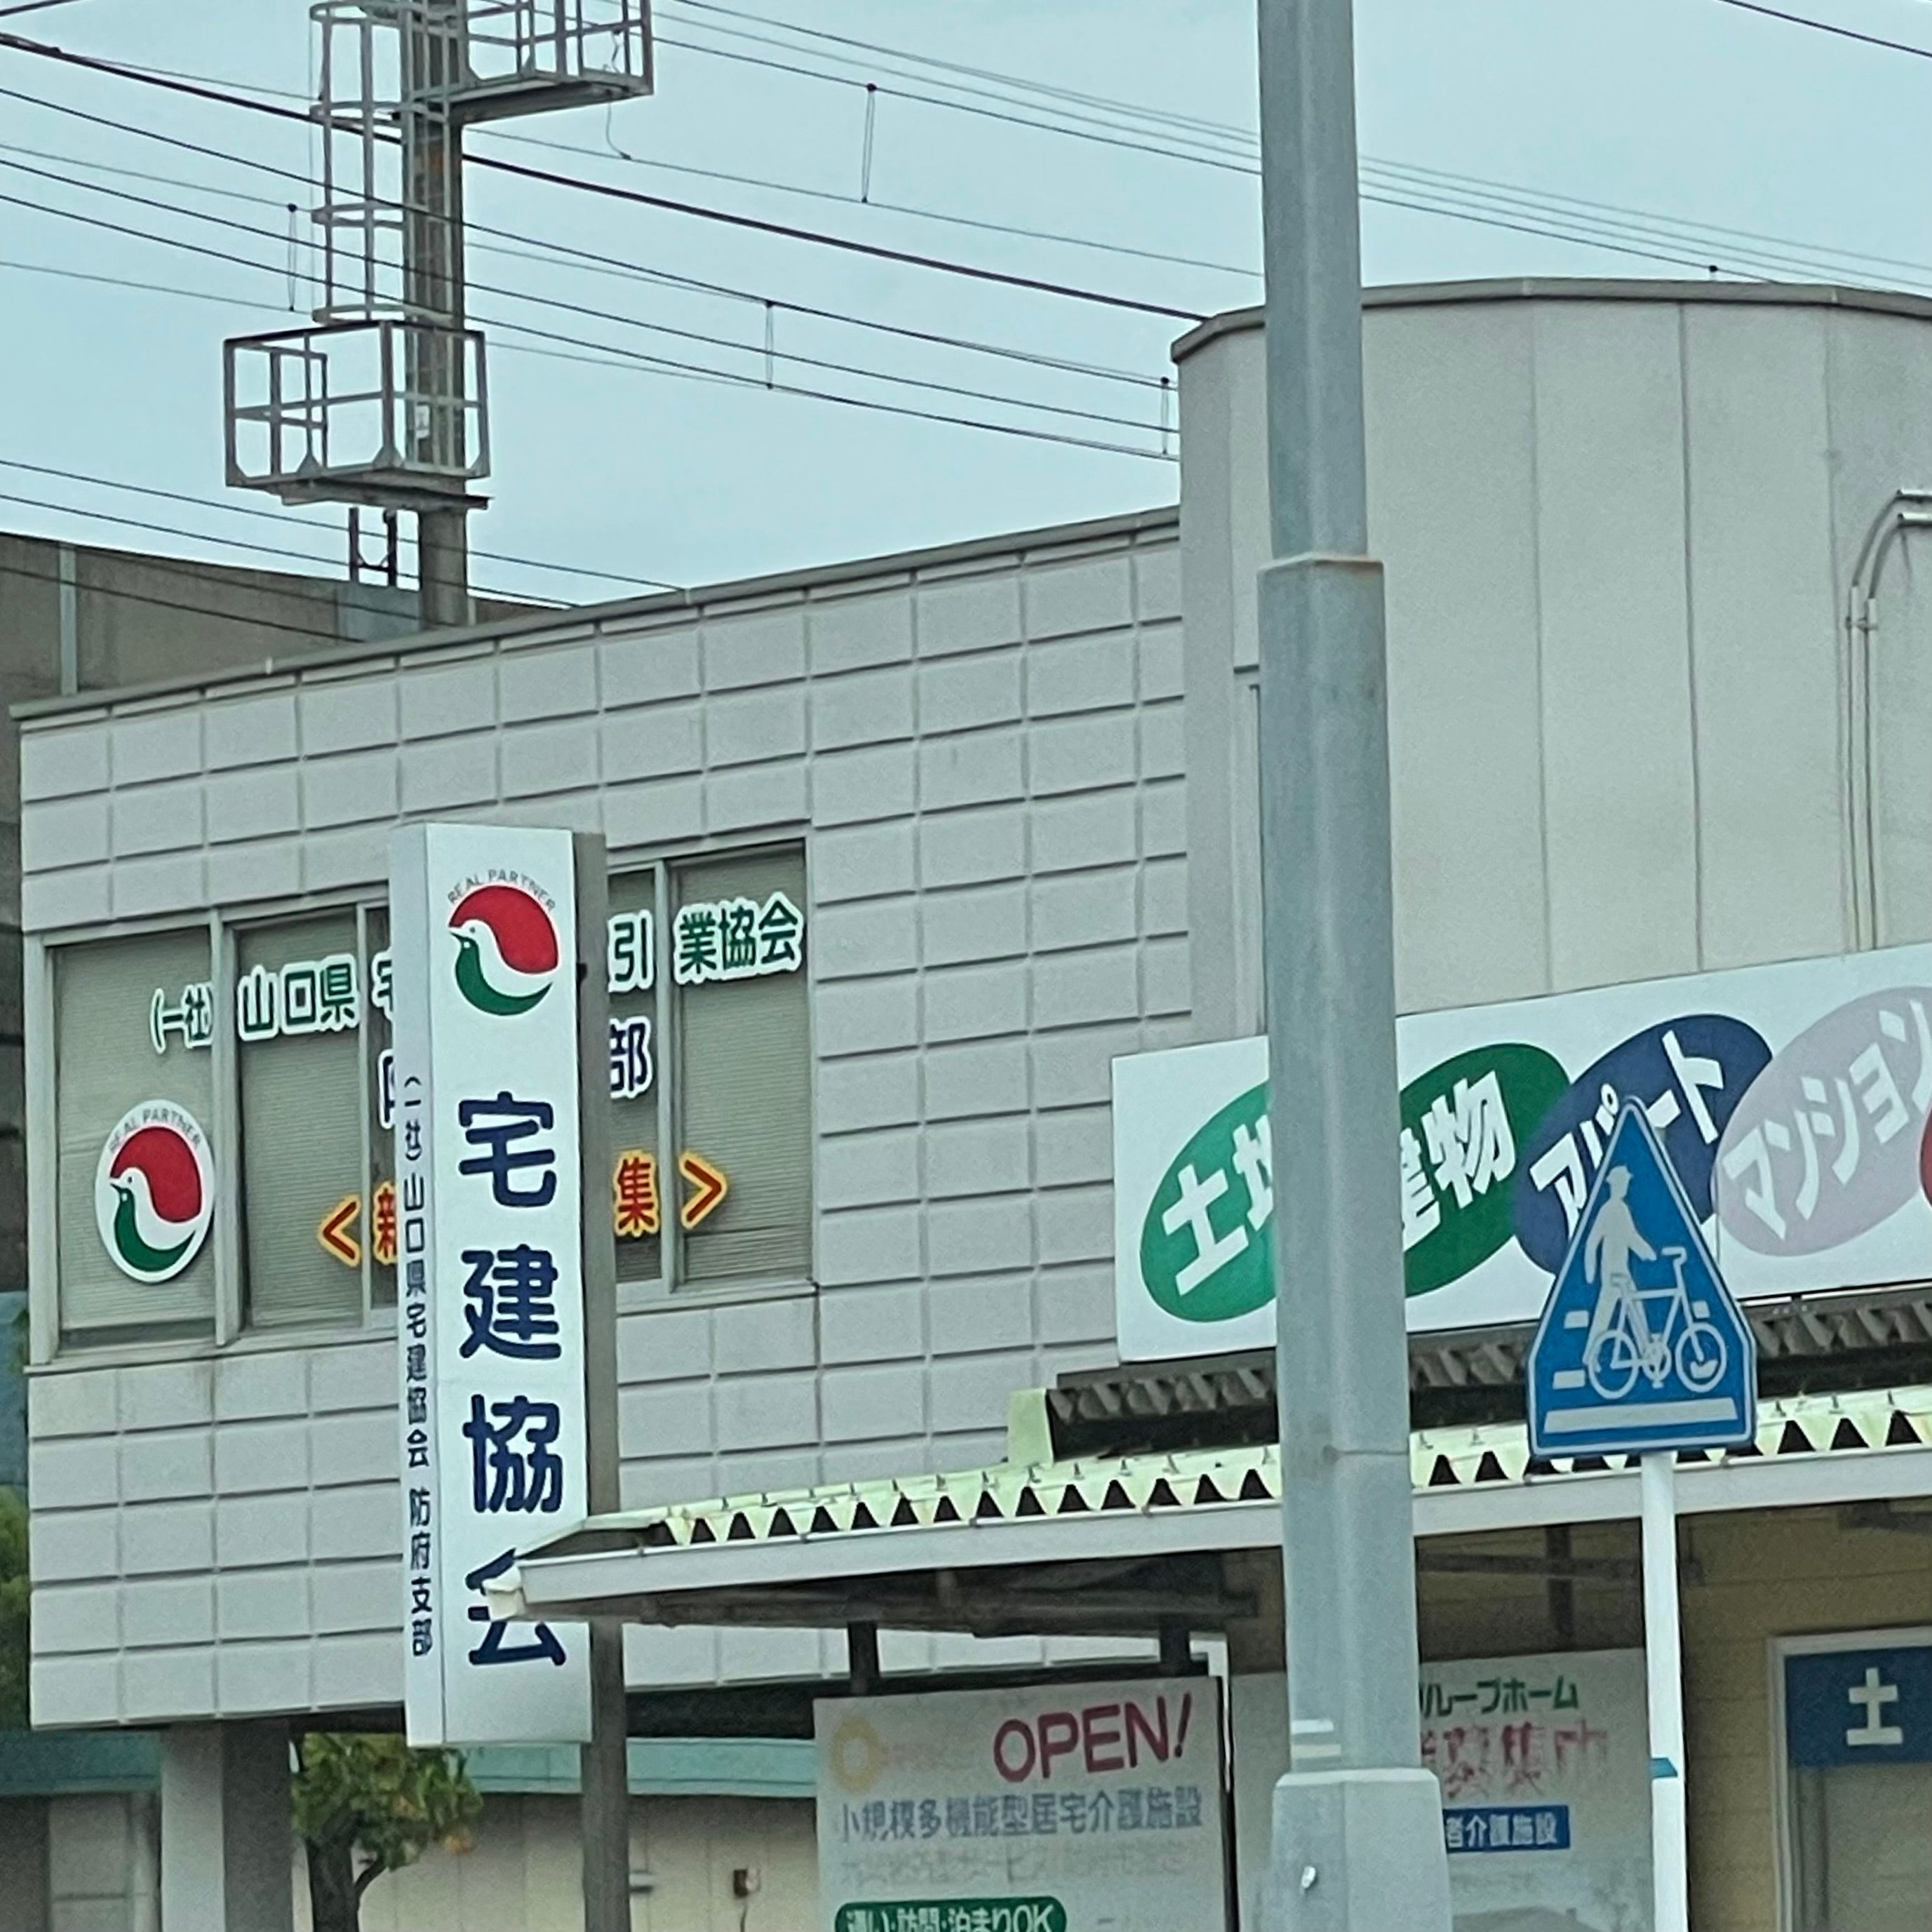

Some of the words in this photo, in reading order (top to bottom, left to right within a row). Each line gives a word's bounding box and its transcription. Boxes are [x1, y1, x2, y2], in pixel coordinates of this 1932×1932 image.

[448, 874, 482, 904] REAL
[488, 869, 556, 911] PARTNER
[1418, 1675, 1579, 1719] ループホーム
[1846, 1667, 1903, 1746] 土
[993, 1691, 1192, 1783] OPEN!
